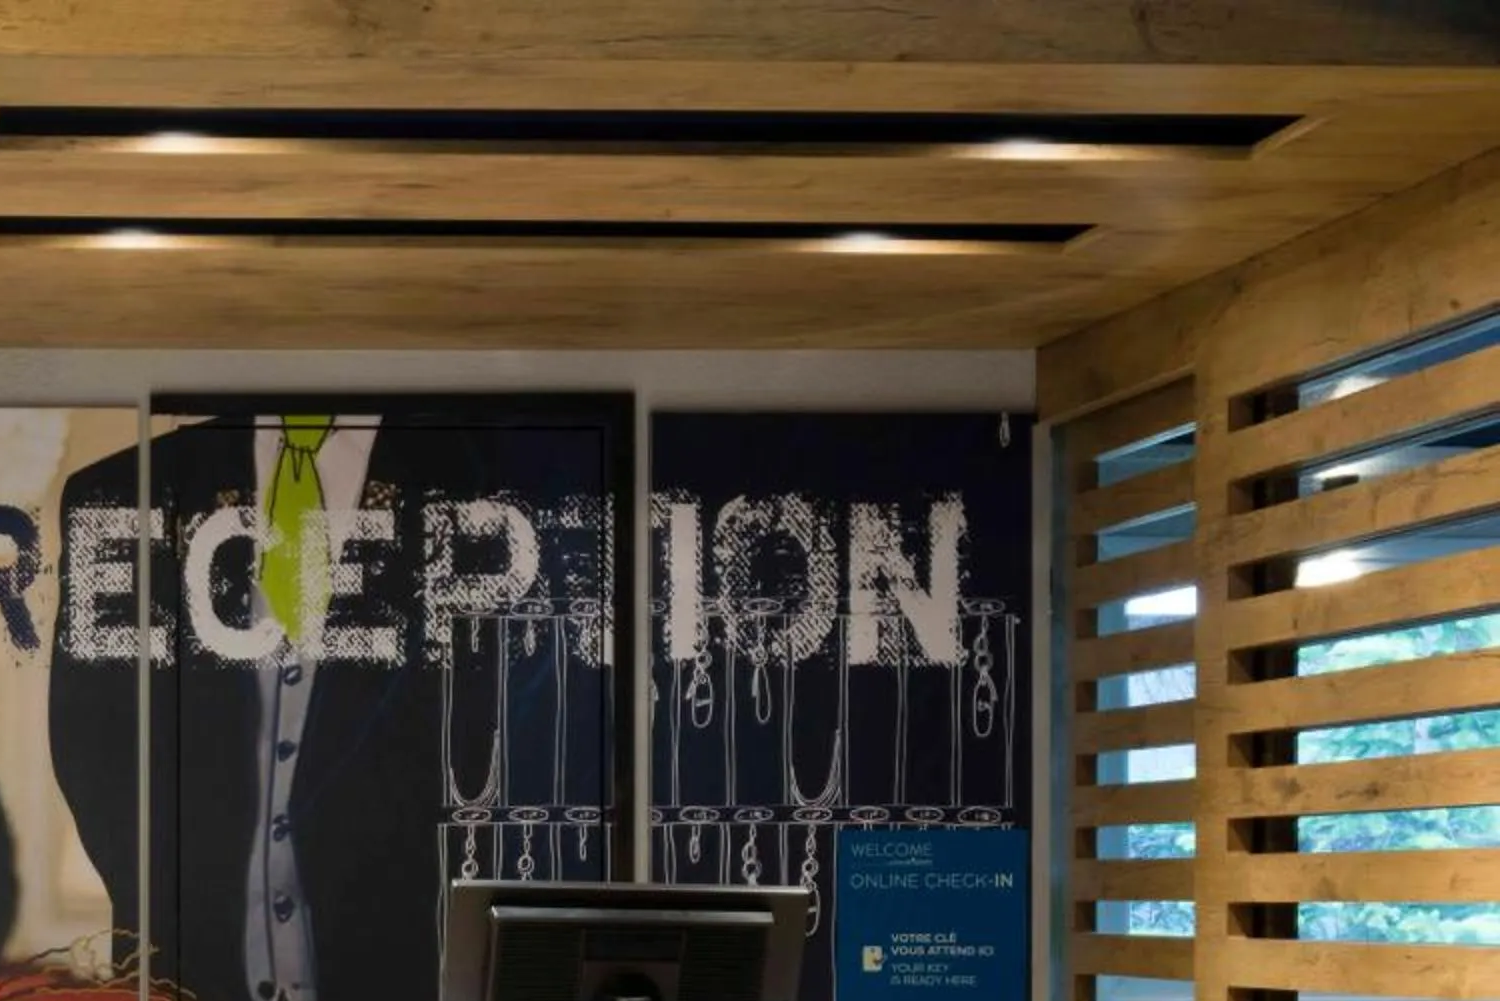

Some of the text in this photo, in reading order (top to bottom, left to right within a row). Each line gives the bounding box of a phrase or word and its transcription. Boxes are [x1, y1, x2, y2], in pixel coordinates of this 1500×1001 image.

[851, 843, 932, 858] WELCOME
[850, 872, 1014, 890] ONLINE CHECK-IN
[891, 933, 932, 944] VOTRE
